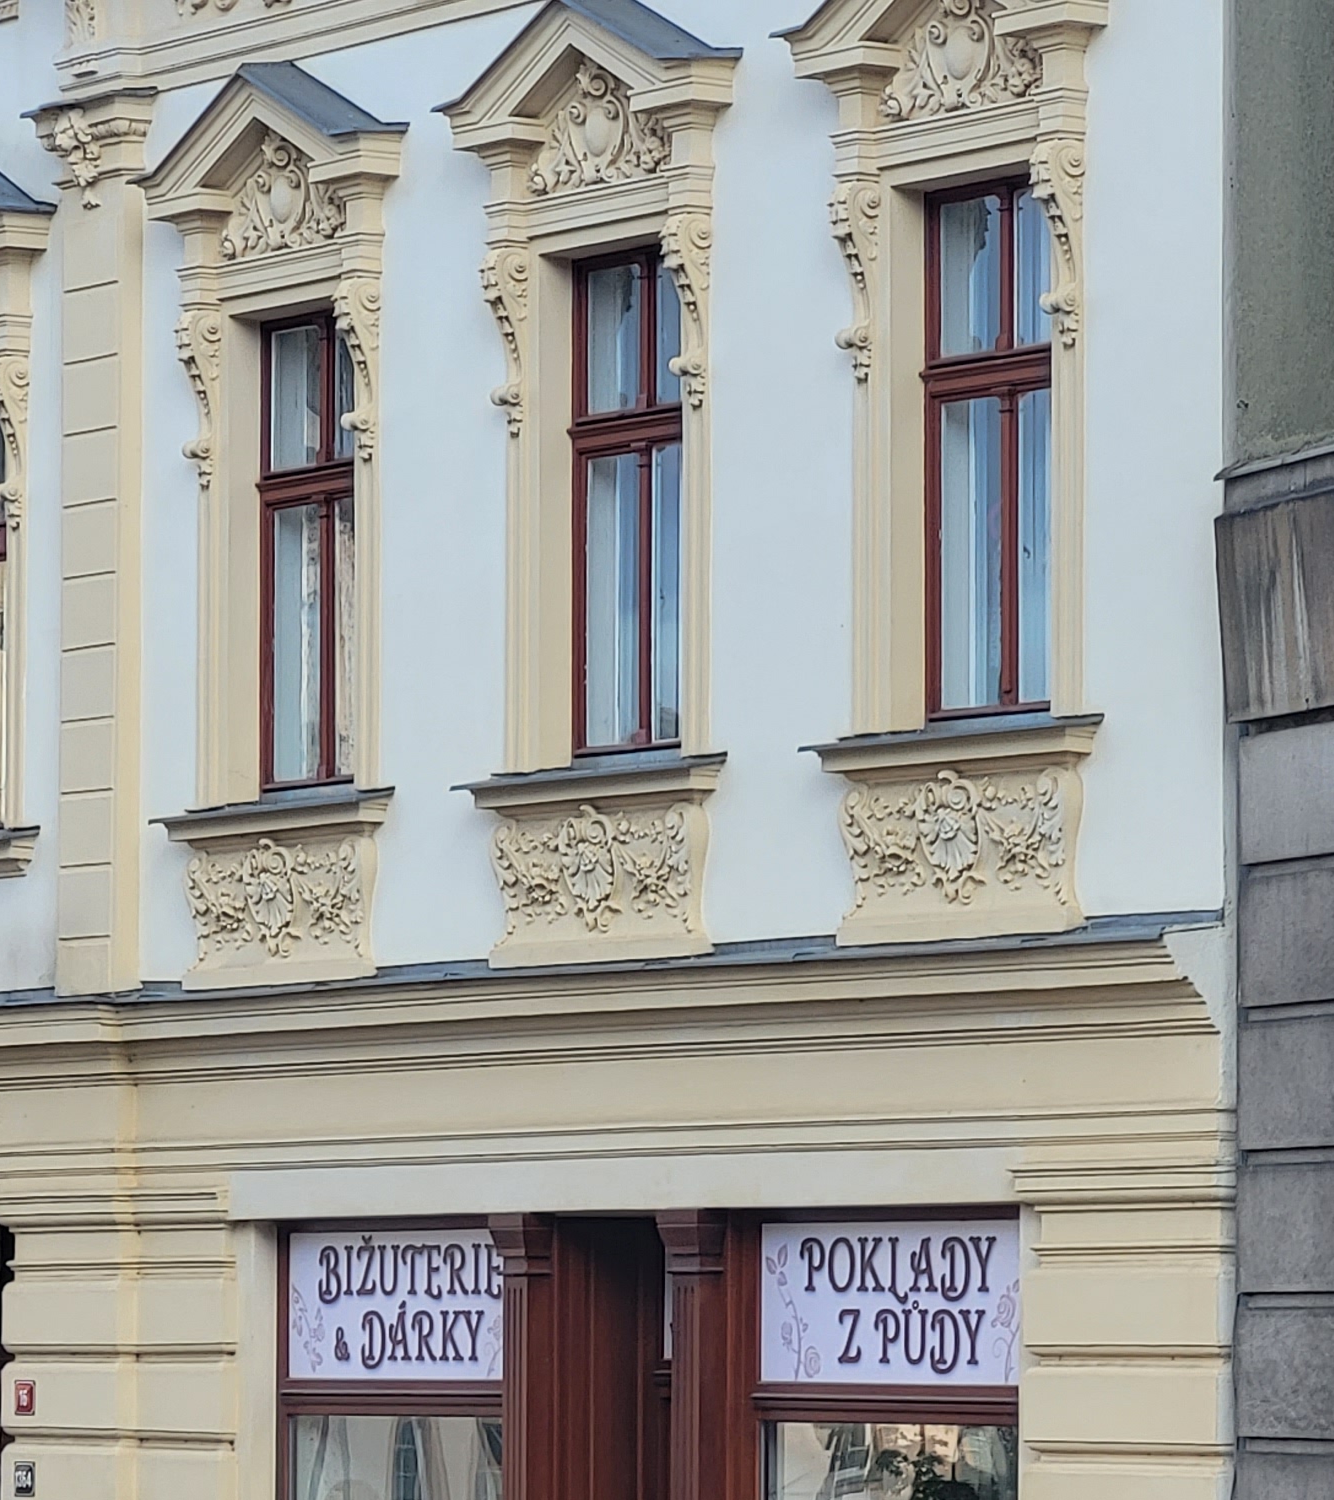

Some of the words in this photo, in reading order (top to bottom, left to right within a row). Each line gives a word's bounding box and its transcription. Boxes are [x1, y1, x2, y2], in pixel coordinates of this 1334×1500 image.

[318, 1234, 503, 1305] BIŽUTERIE
[799, 1235, 998, 1302] POKLADY
[334, 1326, 350, 1362] &
[362, 1301, 485, 1369] DÁRKY
[837, 1308, 861, 1364] Z
[874, 1299, 985, 1374] PŮDY
